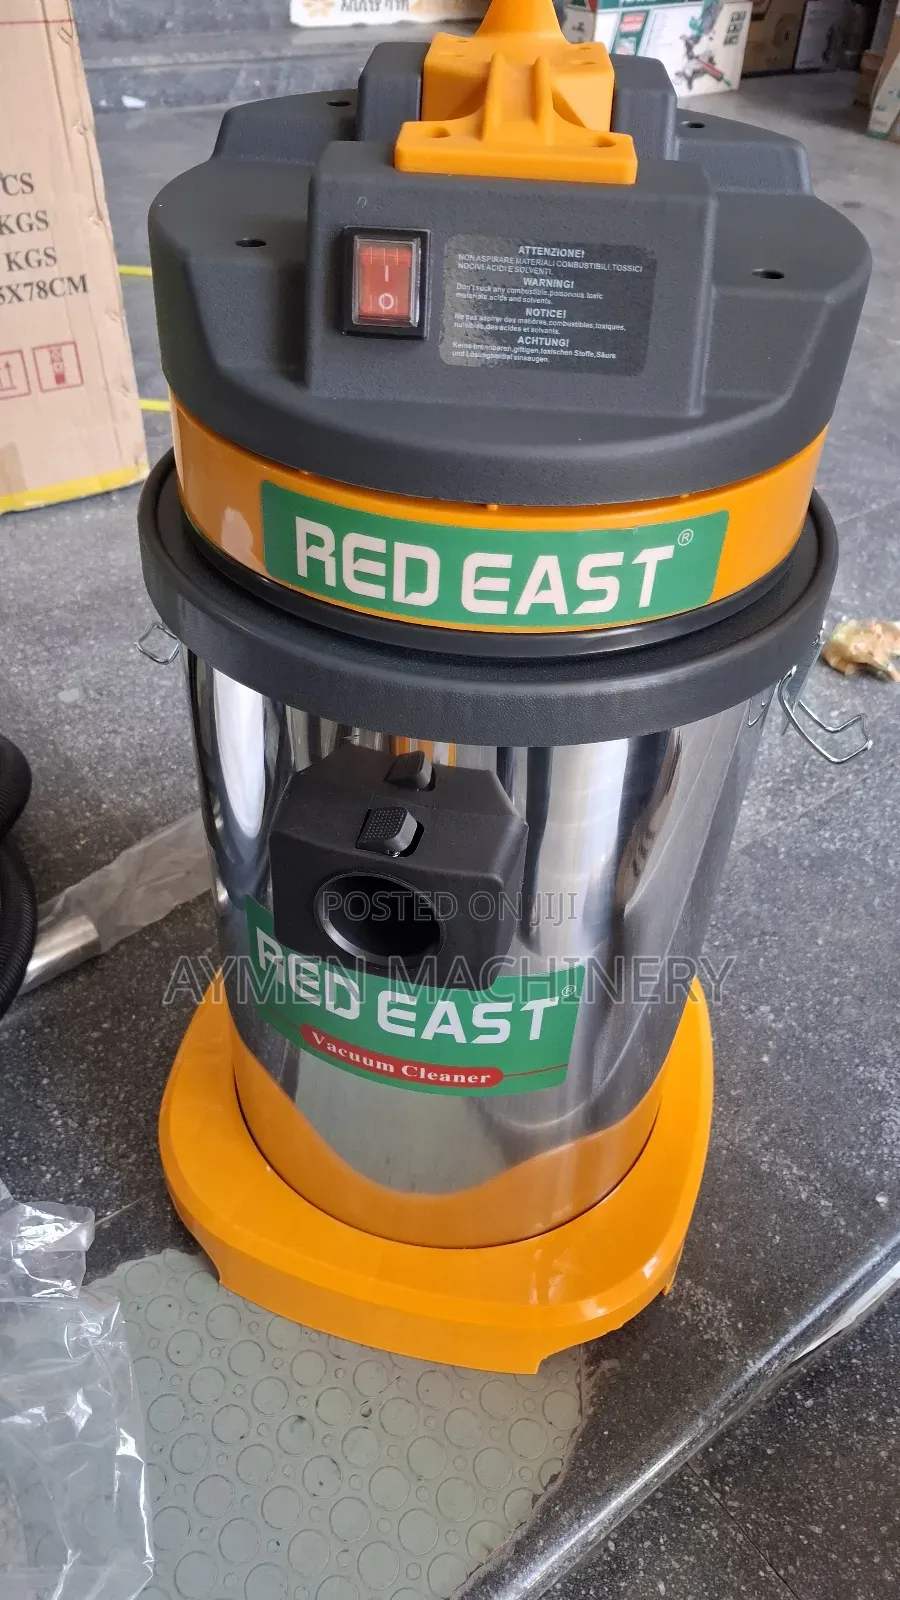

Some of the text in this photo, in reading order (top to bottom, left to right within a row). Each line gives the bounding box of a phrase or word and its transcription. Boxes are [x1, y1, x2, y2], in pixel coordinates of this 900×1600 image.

[0, 171, 35, 196] CS
[518, 246, 585, 258] ATTENZIONE!
[4, 245, 58, 272] KGS
[475, 255, 514, 264] ASPIRARE
[516, 258, 555, 266] MATERIALI
[523, 278, 574, 288] WARNING!
[492, 286, 505, 294] any
[454, 312, 465, 320] Ne
[465, 314, 478, 322] pas
[503, 316, 517, 324] des
[525, 308, 567, 318] NOTICE!
[517, 336, 569, 347] ACHTUNG!
[452, 350, 465, 358] und
[295, 516, 440, 607] RED
[461, 544, 675, 616] EAST
[256, 926, 360, 1020] RED
[377, 990, 560, 1045] EAST
[310, 1030, 492, 1084] Vacuum Cleaner
